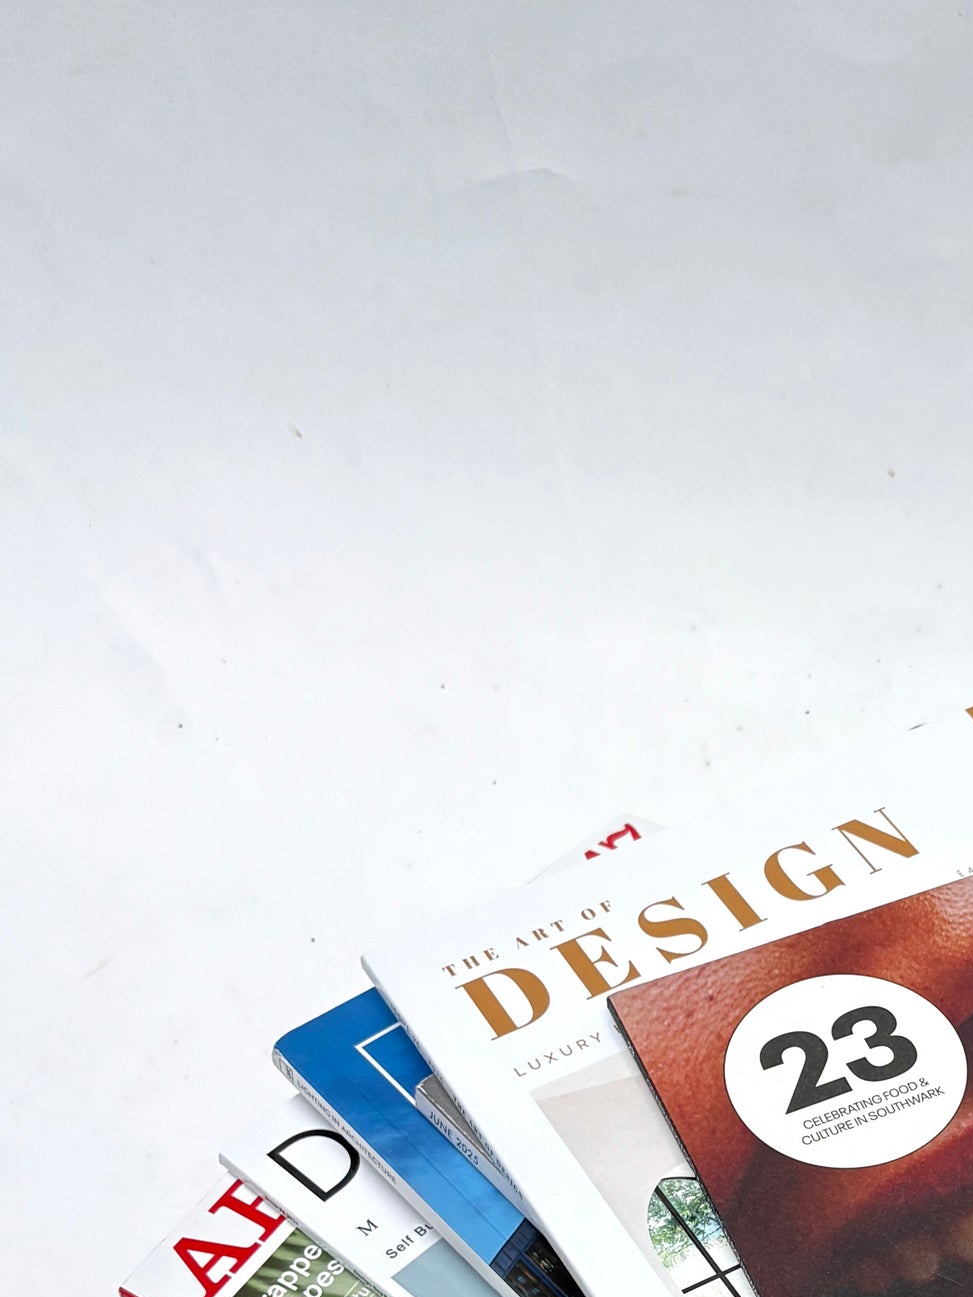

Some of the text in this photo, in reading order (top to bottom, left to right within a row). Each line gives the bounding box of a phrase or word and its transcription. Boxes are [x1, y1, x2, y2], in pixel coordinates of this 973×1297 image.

[442, 899, 614, 977] THE ART OF
[455, 807, 920, 1040] DESIGN
[513, 1032, 602, 1077] LUXURY
[759, 1005, 918, 1115] 23
[801, 1086, 945, 1146] CULTURE IN SOUTHWARK
[802, 1077, 930, 1130] CELEBRATING FOOD &
[266, 1129, 361, 1202] D
[340, 1126, 398, 1184] ARCHITECTURE
[426, 1110, 456, 1138] JUNE
[452, 1137, 482, 1165] 2025
[356, 1219, 379, 1237] M
[386, 1235, 414, 1259] Self
